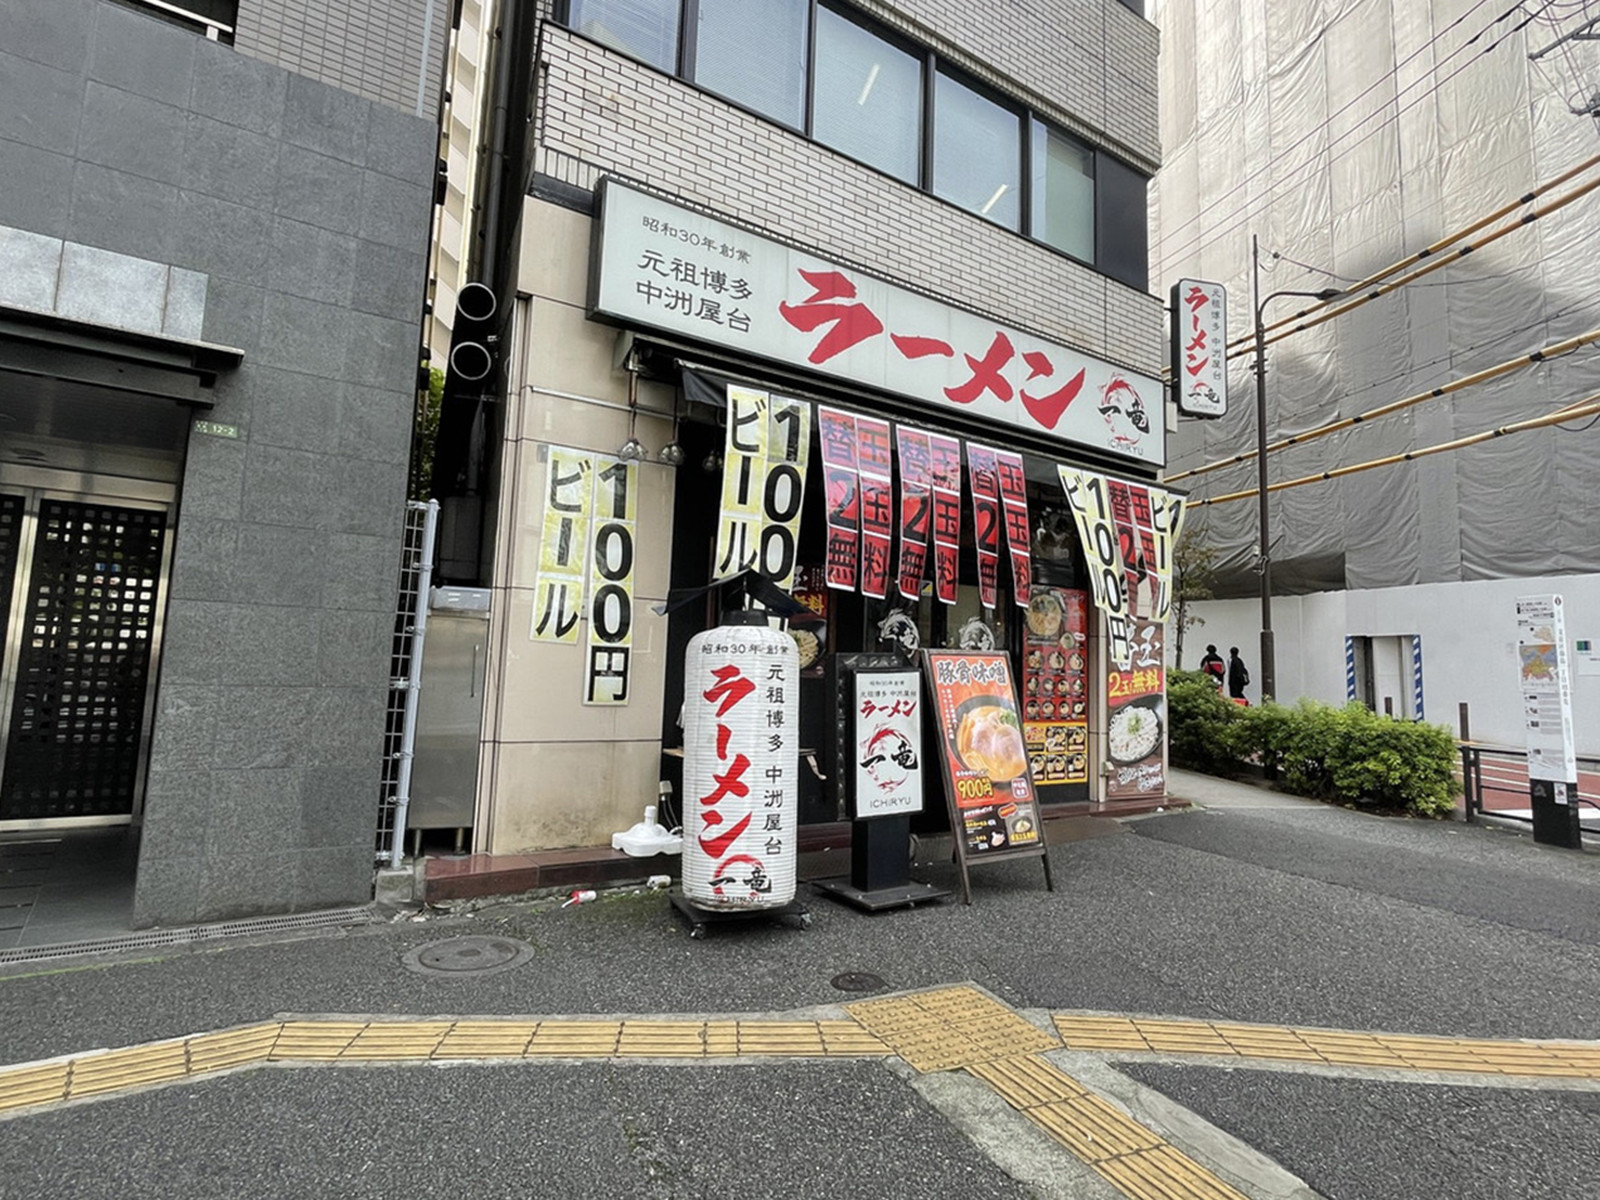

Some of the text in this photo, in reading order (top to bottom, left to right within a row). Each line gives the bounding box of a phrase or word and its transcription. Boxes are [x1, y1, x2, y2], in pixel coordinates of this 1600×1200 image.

[637, 249, 753, 301] 元祖博多
[642, 215, 751, 264] 昭和30年創業
[636, 280, 752, 334] 中洲屋台
[778, 268, 1086, 430] ラーメン
[1184, 286, 1210, 377] ラーメン
[719, 398, 767, 574] ビール
[536, 459, 591, 637] ビール
[587, 463, 633, 702] 100円
[1087, 477, 1130, 661] 100円
[702, 643, 789, 655] 昭和30年創業
[936, 660, 1008, 685] 豚骨味噌
[860, 699, 917, 719] ラーメン
[698, 664, 756, 859] ラーメン
[762, 664, 786, 856] 元祖博多 中洲屋台
[869, 796, 912, 809] ICHIRYU
